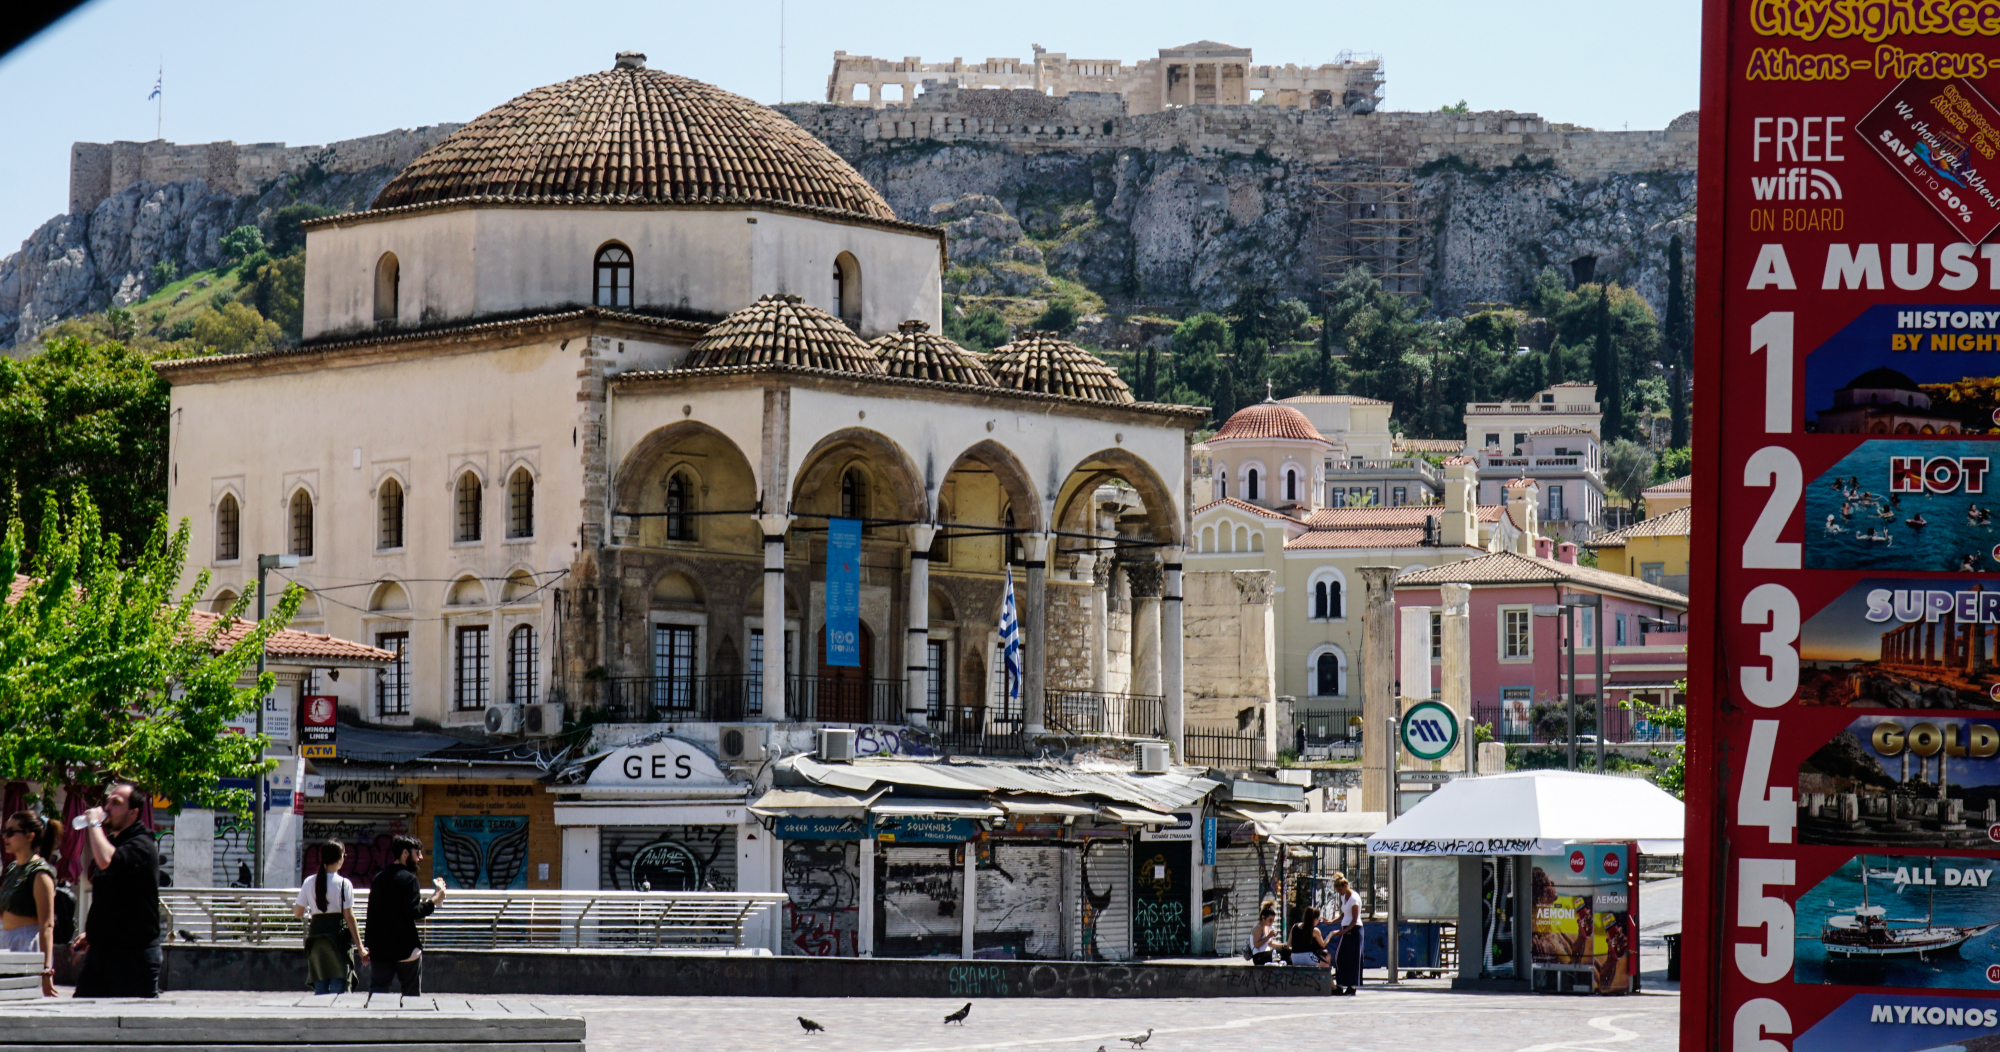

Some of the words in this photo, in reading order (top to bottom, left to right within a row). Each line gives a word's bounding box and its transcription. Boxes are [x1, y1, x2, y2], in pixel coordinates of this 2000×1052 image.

[1746, 47, 1851, 81] Athens
[1875, 44, 1988, 79] Piraeus
[1753, 116, 1846, 162] FREE
[1894, 100, 1914, 121] We
[1910, 120, 1941, 149] show
[1930, 148, 1964, 171] you
[1930, 94, 1969, 134] Athens
[1969, 131, 1996, 160] Pass
[1751, 168, 1807, 200] wifi
[1879, 129, 1918, 167] SAVE
[1913, 163, 1927, 177] UP
[1925, 176, 1939, 190] TO
[1938, 187, 1973, 223] 50%
[1750, 208, 1776, 231] ON
[1783, 208, 1845, 231] BOARD
[1746, 243, 1797, 290] A
[1897, 310, 2000, 329] HISTORY
[1892, 333, 1923, 351] BY
[1750, 311, 1795, 434] 1
[1889, 455, 1990, 494] HOT
[1742, 445, 1803, 569] 2
[1865, 588, 2000, 624] SUPER
[1739, 583, 1801, 708] 3
[306, 746, 333, 755] ATM
[1871, 721, 2000, 758] GOLD
[623, 754, 692, 780] GES
[1737, 719, 1798, 844] 4
[341, 788, 363, 806] old
[366, 789, 414, 807] mosque
[726, 809, 737, 818] 97
[784, 824, 809, 832] GREEK
[907, 822, 953, 833] SOUVENIRS
[1892, 866, 1938, 887] ALL
[1944, 868, 1993, 888] DAY
[1734, 857, 1797, 984] 5
[1732, 997, 1793, 1052] 6
[1870, 1004, 1998, 1028] MYKONOS
